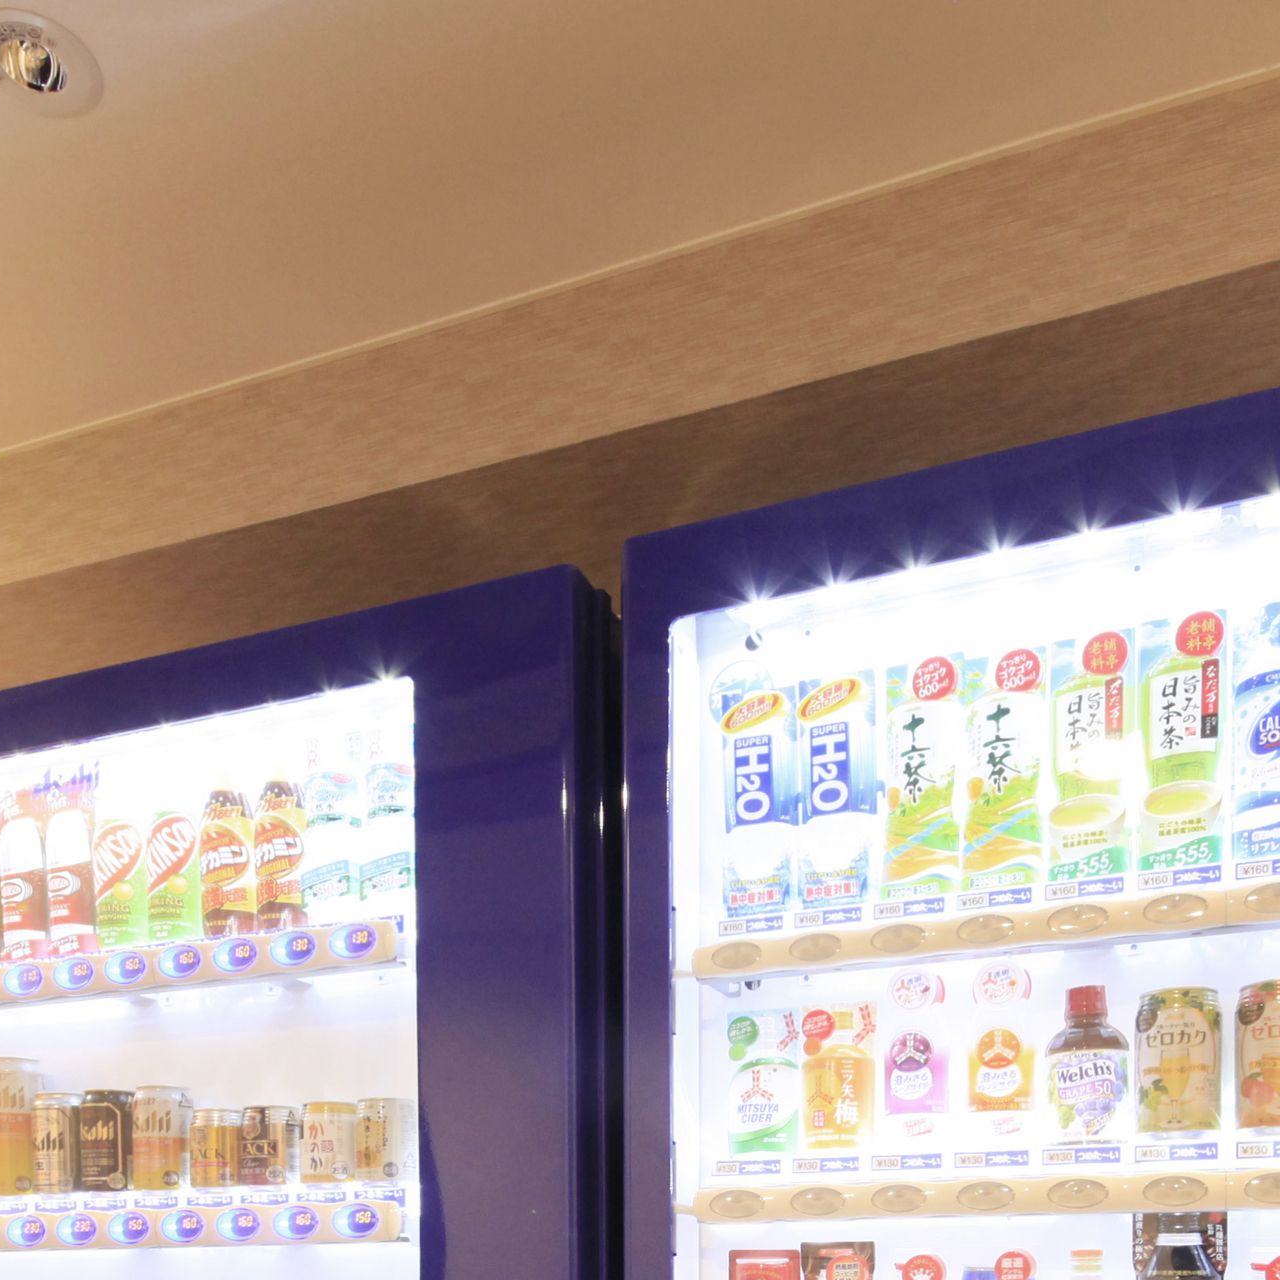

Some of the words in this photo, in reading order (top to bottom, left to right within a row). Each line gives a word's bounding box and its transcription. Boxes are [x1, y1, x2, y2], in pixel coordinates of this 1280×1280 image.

[1186, 617, 1216, 636] 老舗
[1186, 634, 1217, 652] 料亭
[1182, 675, 1201, 724] 旨みの
[1158, 677, 1184, 750] 日本茶
[812, 723, 846, 737] SUPER
[736, 736, 769, 748] SUPER
[982, 704, 1022, 794] 十六茶
[900, 713, 936, 804] 十六茶
[735, 745, 770, 821] H2O
[812, 733, 849, 812] H2O
[1144, 1029, 1207, 1049] ゼロカク
[1056, 1060, 1114, 1085] Welch's
[1059, 1085, 1093, 1099] GRAPE
[1094, 1081, 1112, 1096] 50
[736, 1103, 780, 1115] MITSUYA
[740, 1113, 773, 1124] CIDER
[834, 1099, 859, 1127] 梅
